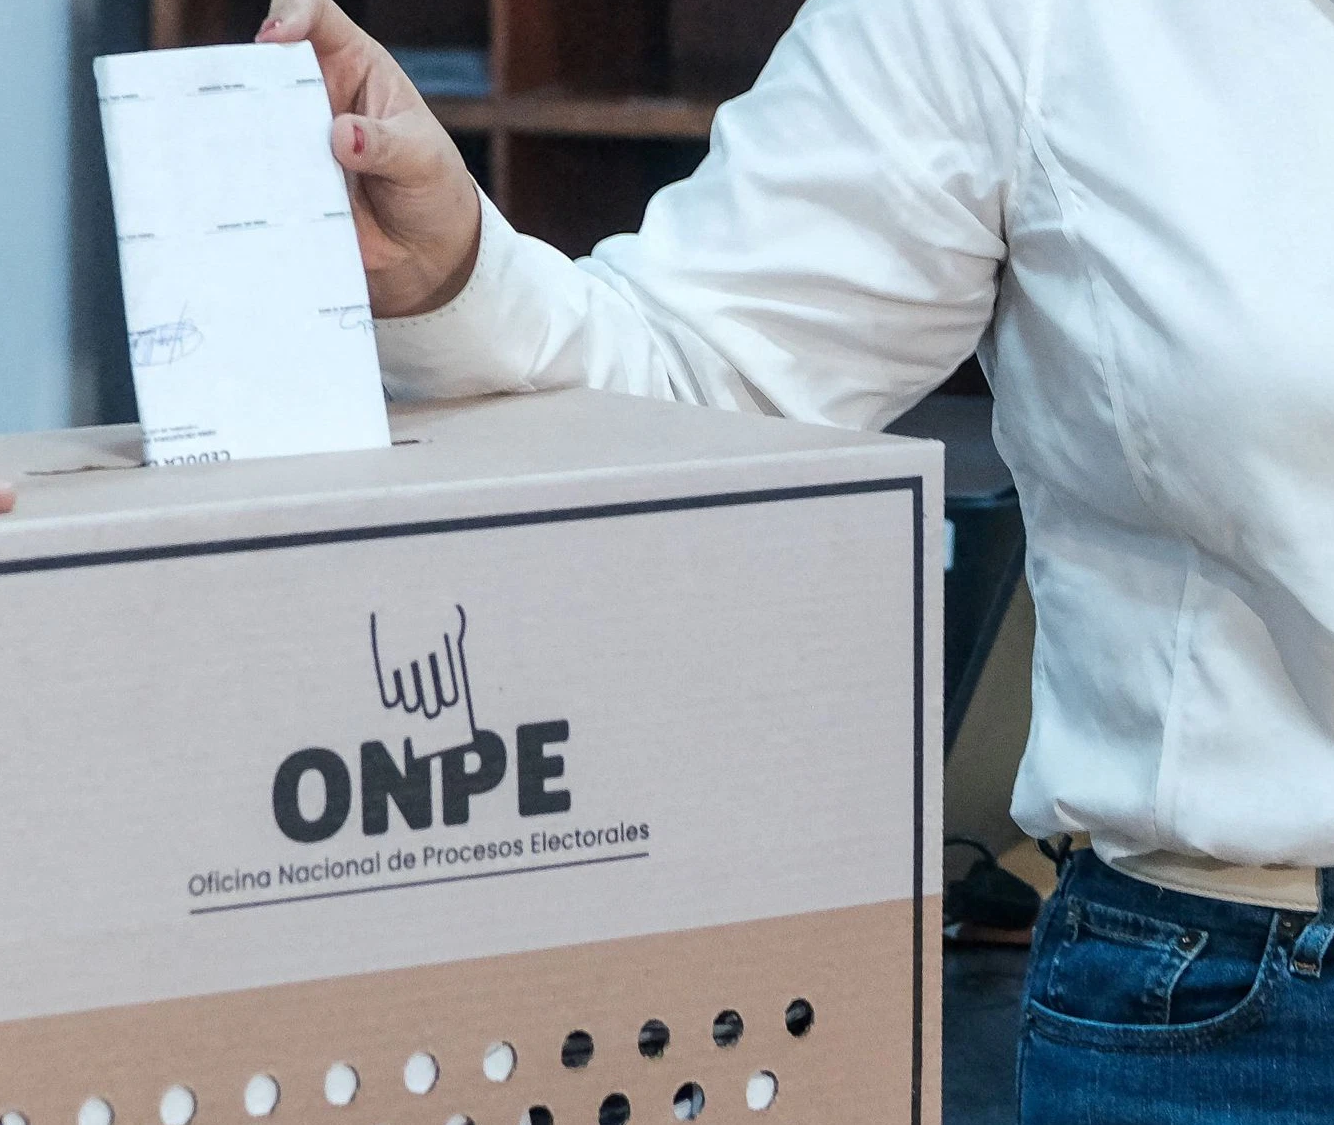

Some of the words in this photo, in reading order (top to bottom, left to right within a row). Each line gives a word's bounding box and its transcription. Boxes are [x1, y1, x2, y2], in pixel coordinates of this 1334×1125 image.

[272, 719, 571, 844] ONPE
[187, 866, 272, 896] Oficina
[279, 852, 381, 885] Nacional
[388, 848, 417, 871] de
[423, 838, 524, 866] Procesos
[530, 821, 650, 854] Electorales
